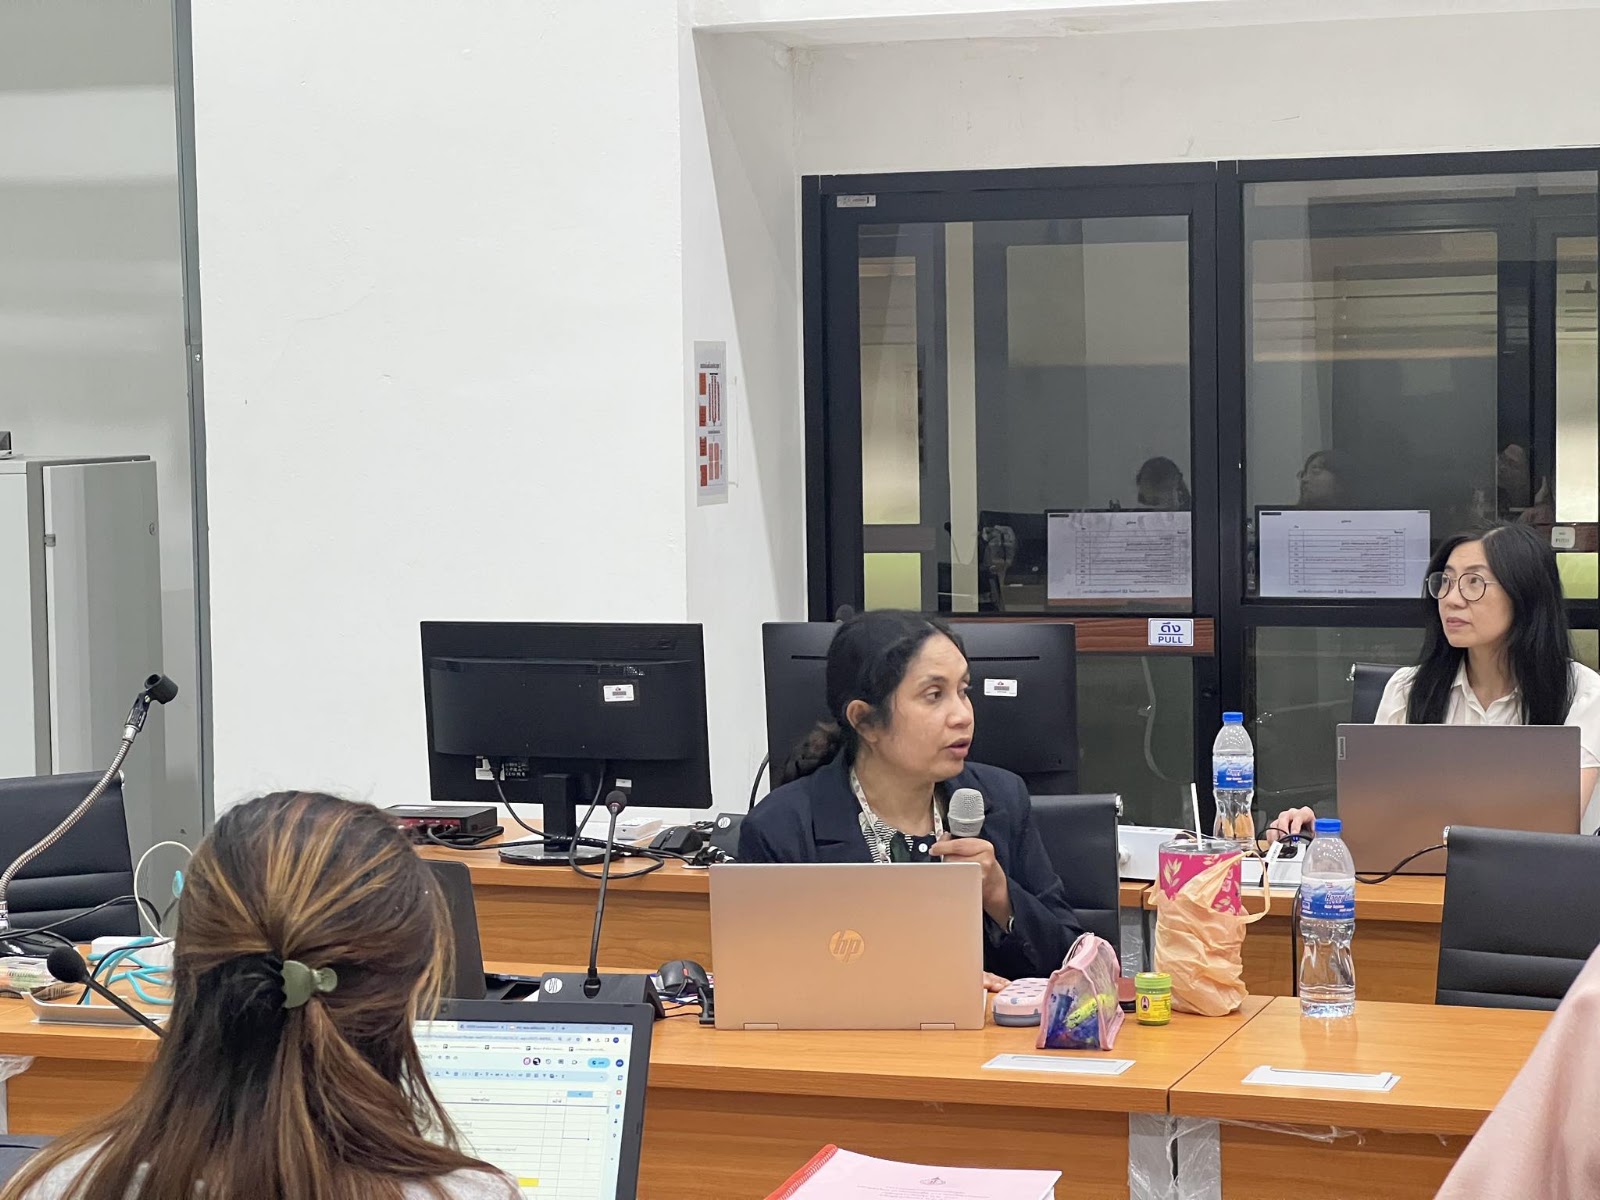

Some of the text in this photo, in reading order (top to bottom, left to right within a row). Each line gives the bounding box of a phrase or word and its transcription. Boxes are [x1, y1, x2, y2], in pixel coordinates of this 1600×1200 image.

[1160, 621, 1181, 633] ดึง
[1158, 636, 1183, 644] PULL
[832, 929, 863, 963] hp
